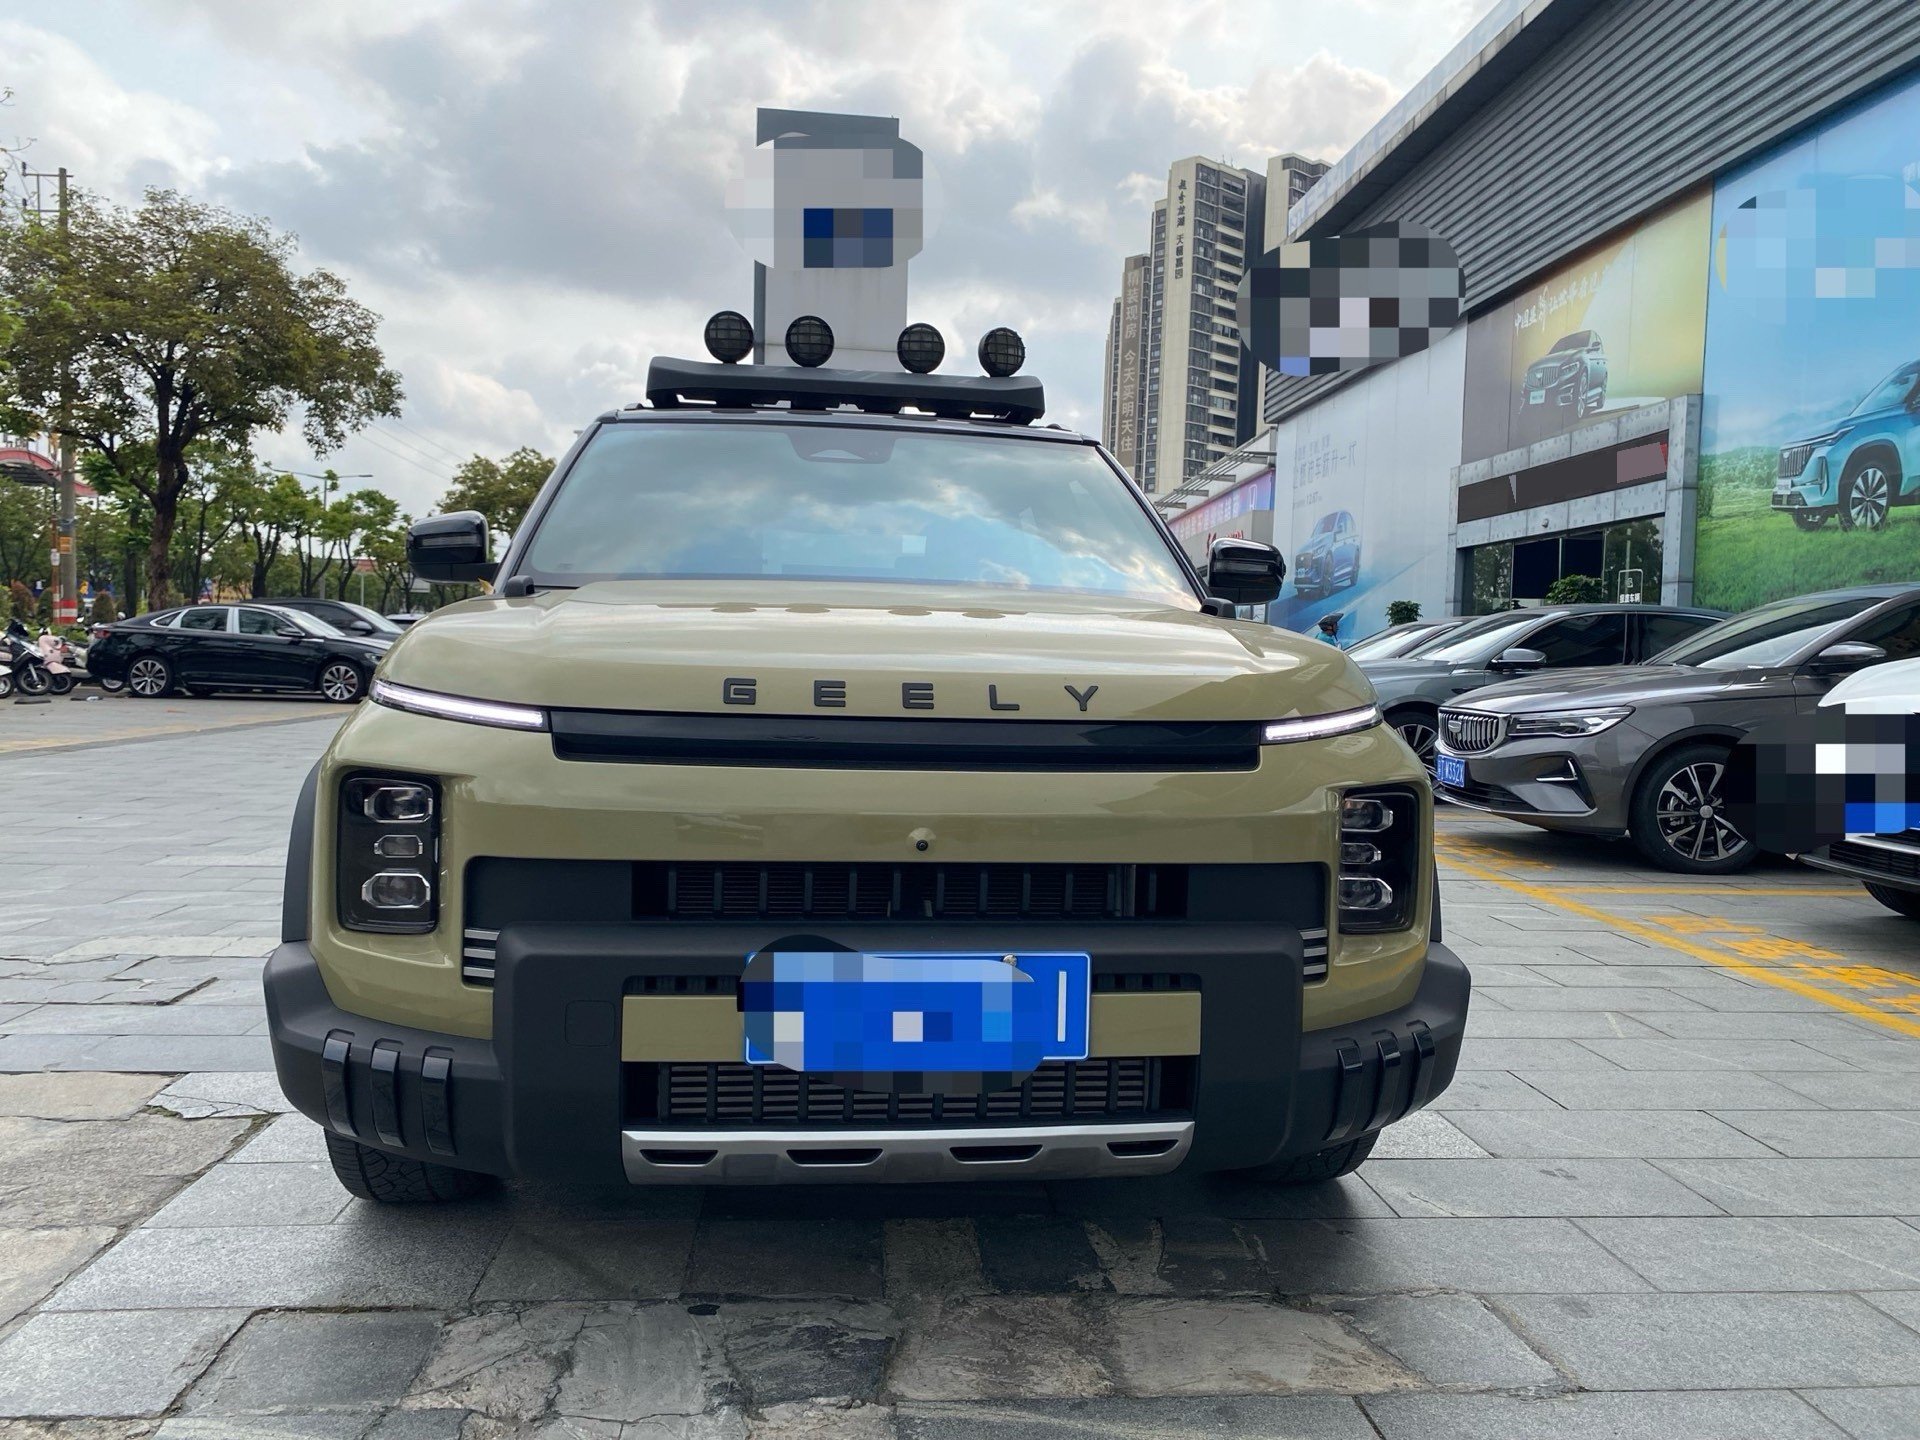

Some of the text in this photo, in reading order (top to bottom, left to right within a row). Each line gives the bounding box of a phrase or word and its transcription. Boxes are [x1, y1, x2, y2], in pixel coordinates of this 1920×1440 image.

[1120, 350, 1137, 452] 今天买明天住
[722, 676, 1100, 712] GEELY
